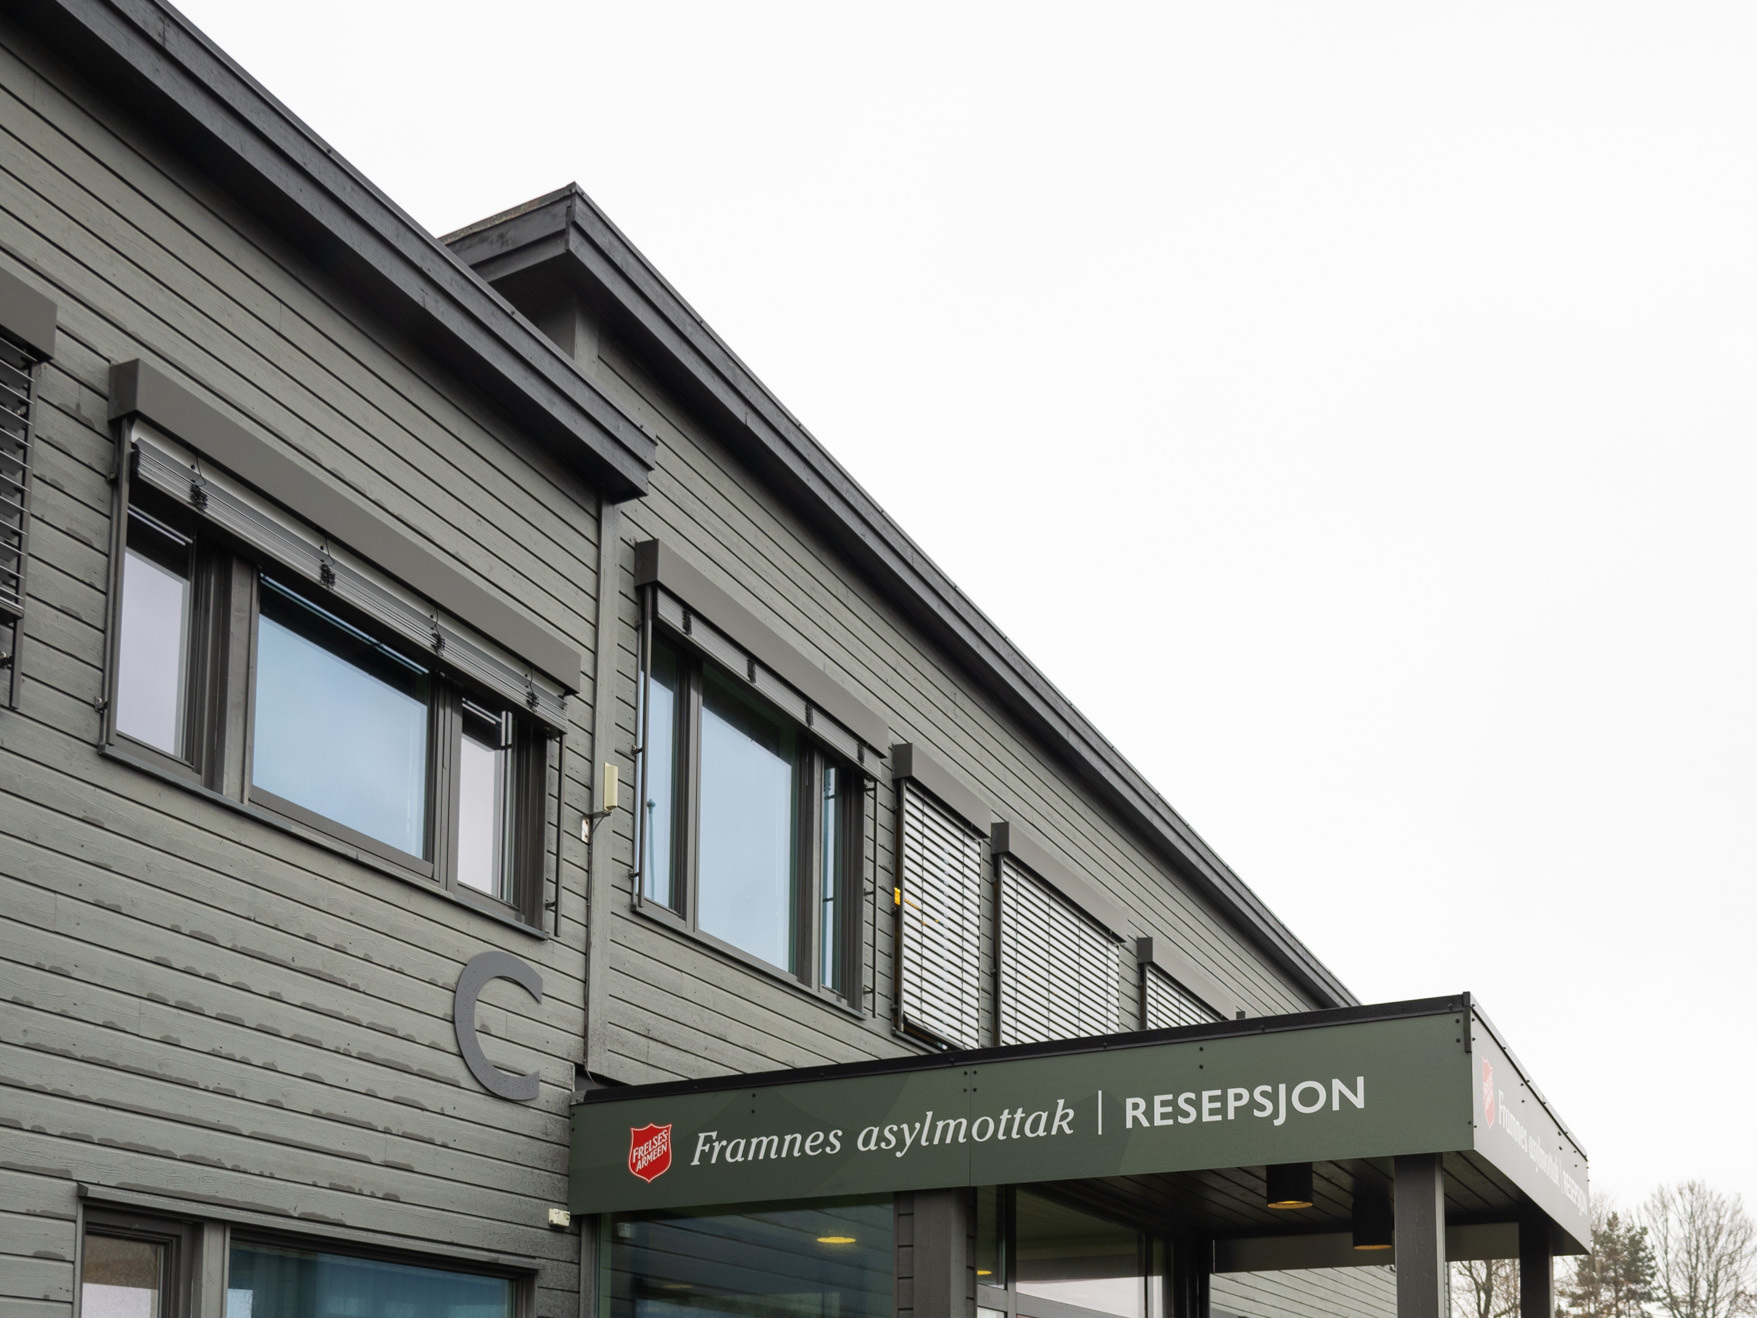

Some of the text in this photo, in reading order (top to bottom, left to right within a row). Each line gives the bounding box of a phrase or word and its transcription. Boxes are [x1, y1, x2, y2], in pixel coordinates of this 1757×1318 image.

[453, 950, 543, 1101] C
[690, 1075, 1366, 1167] Framnes asylmottak RESEPSJON
